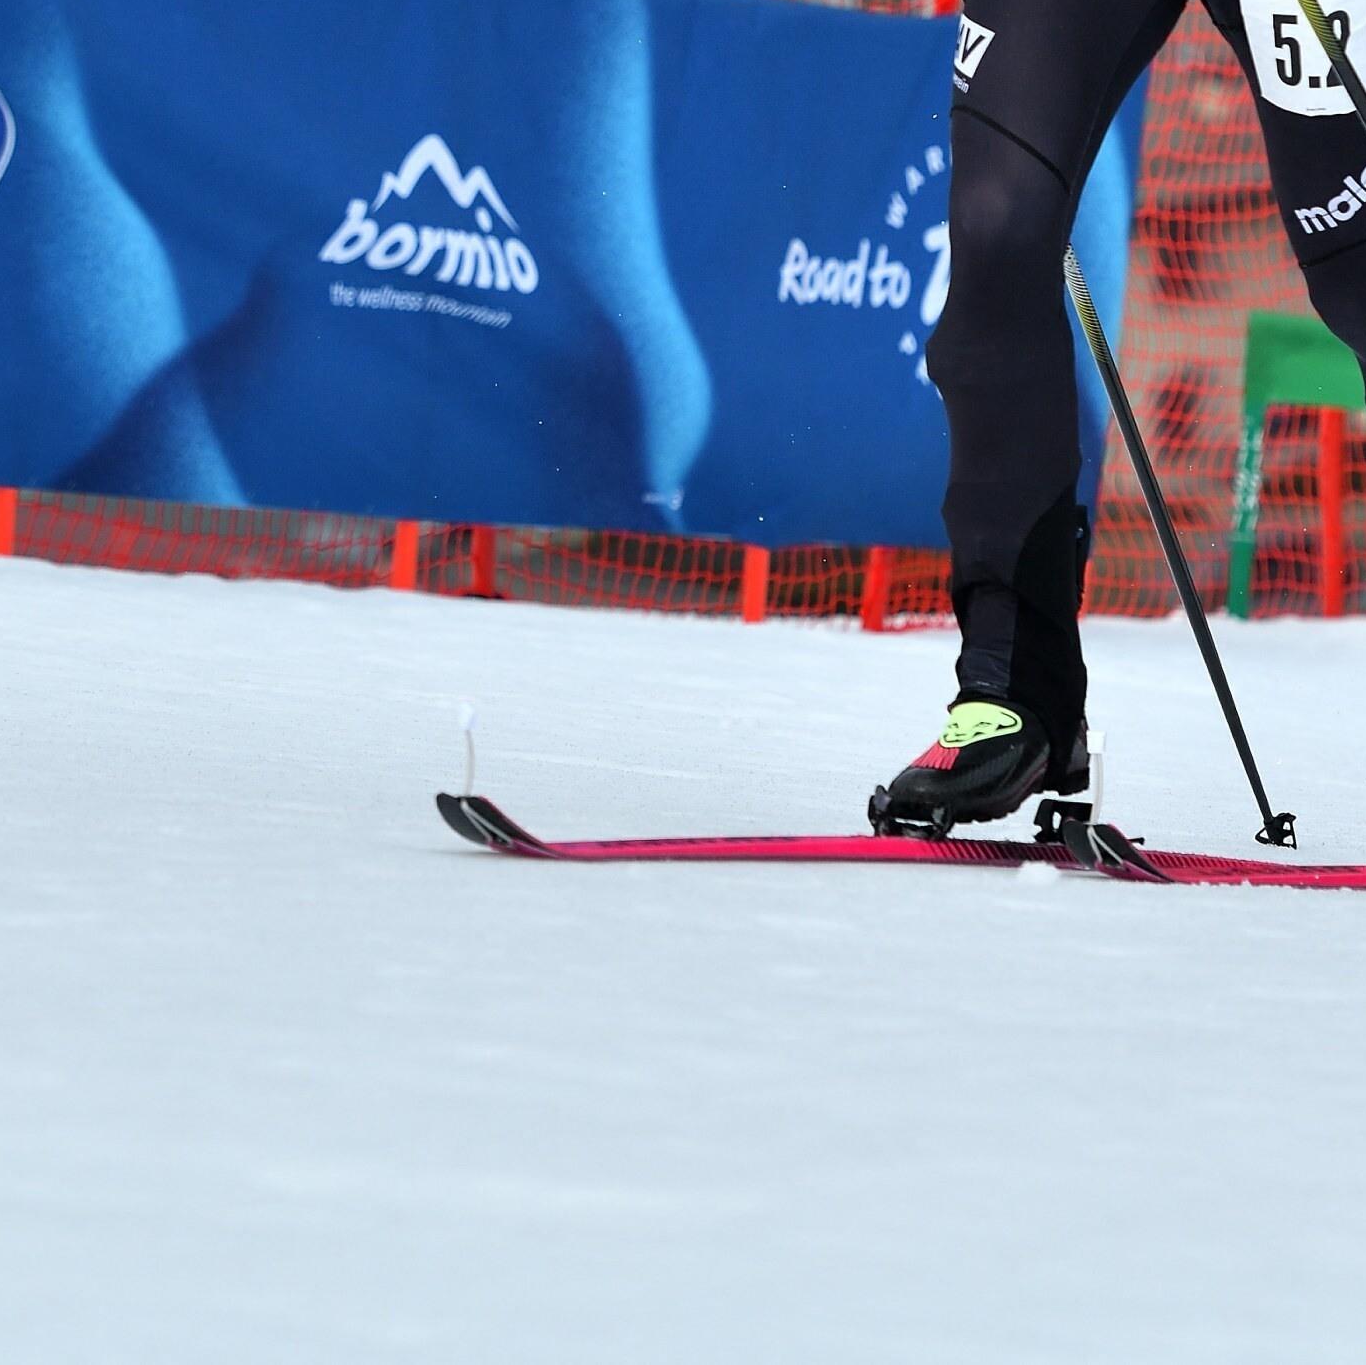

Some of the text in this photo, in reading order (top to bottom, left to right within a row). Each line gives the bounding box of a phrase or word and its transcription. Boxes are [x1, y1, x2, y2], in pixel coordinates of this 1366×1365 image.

[318, 198, 539, 294] bormio
[778, 237, 871, 309] Road
[868, 243, 911, 309] to
[330, 281, 514, 330] the wellness mountain
